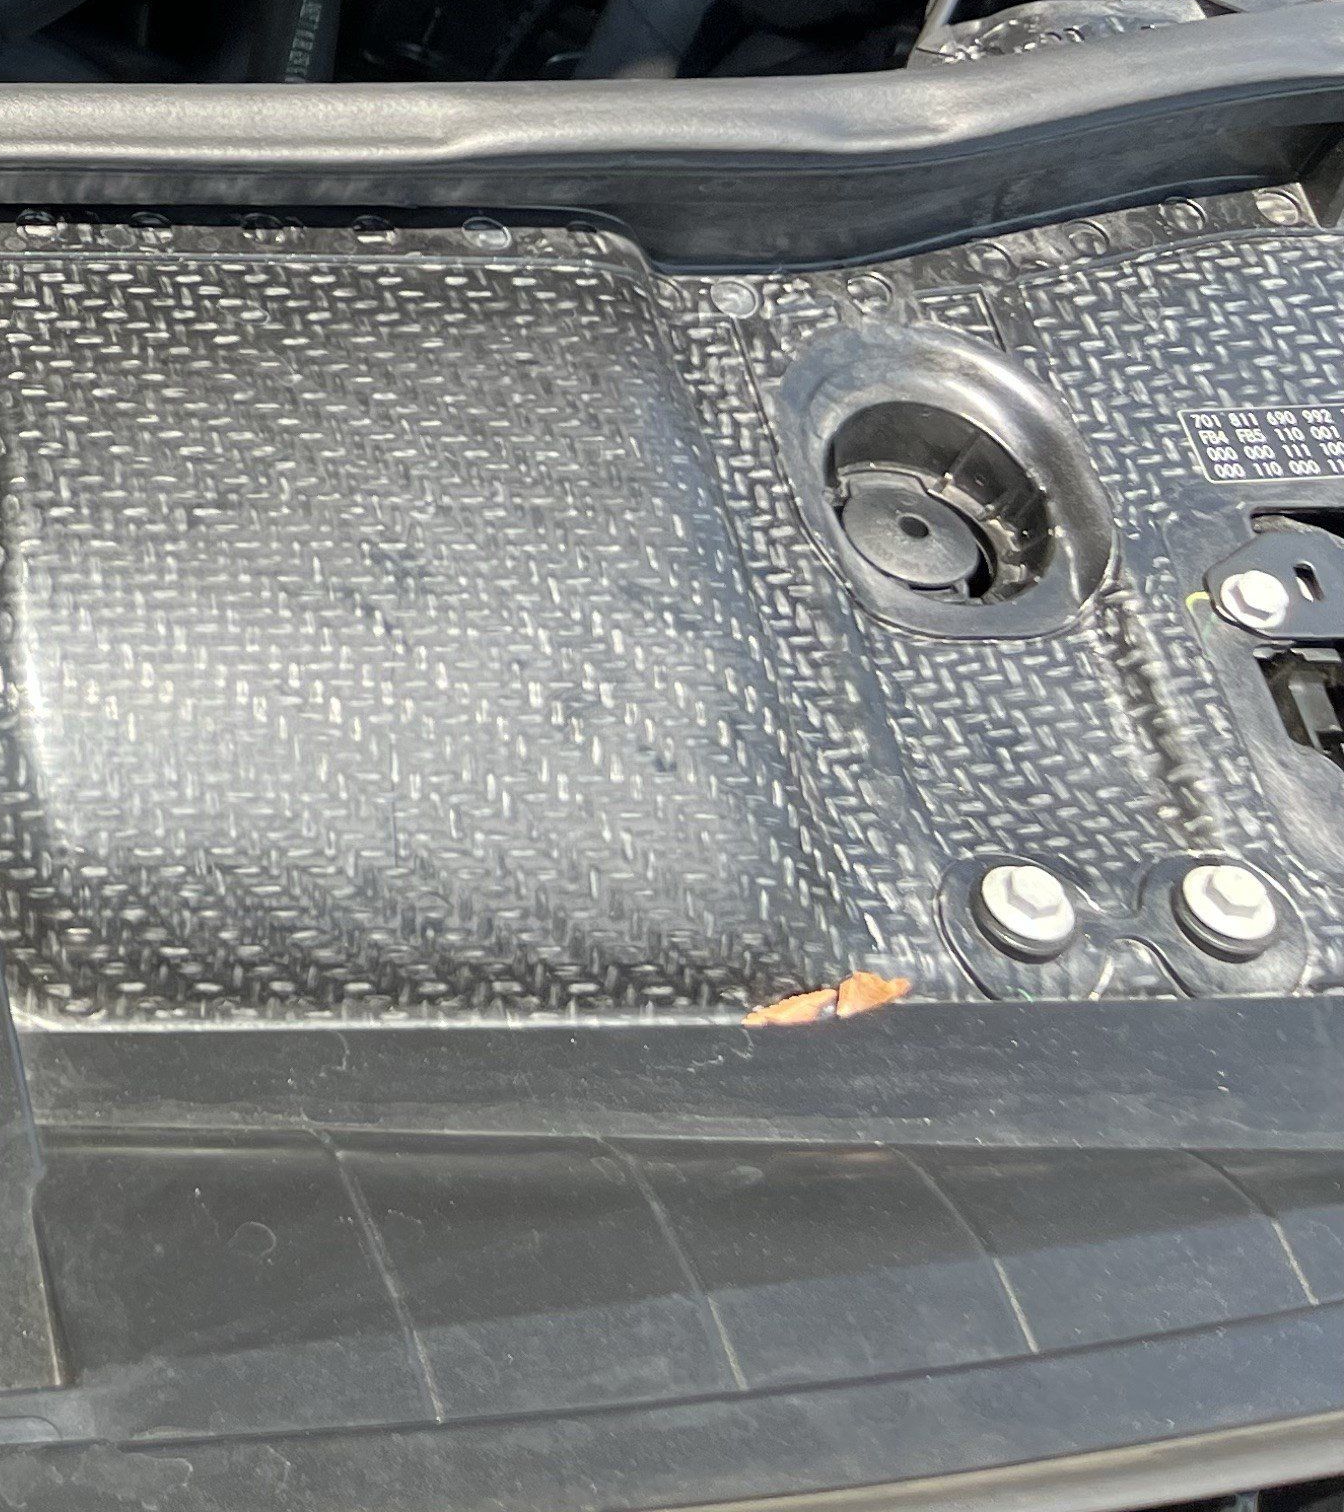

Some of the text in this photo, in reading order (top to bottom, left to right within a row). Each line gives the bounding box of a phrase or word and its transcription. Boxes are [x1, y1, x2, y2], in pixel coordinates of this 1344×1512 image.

[1190, 414, 1222, 428] 701
[1228, 412, 1259, 427] 811
[1266, 410, 1297, 426] 690
[1301, 408, 1334, 424] 992
[1198, 425, 1341, 445] FB4 FB5 110 001
[1206, 446, 1238, 462] 000
[1243, 444, 1276, 460] 000
[1282, 443, 1312, 458] 111
[1214, 463, 1246, 478] 000
[1252, 461, 1284, 477] 110
[1288, 459, 1321, 475] 000
